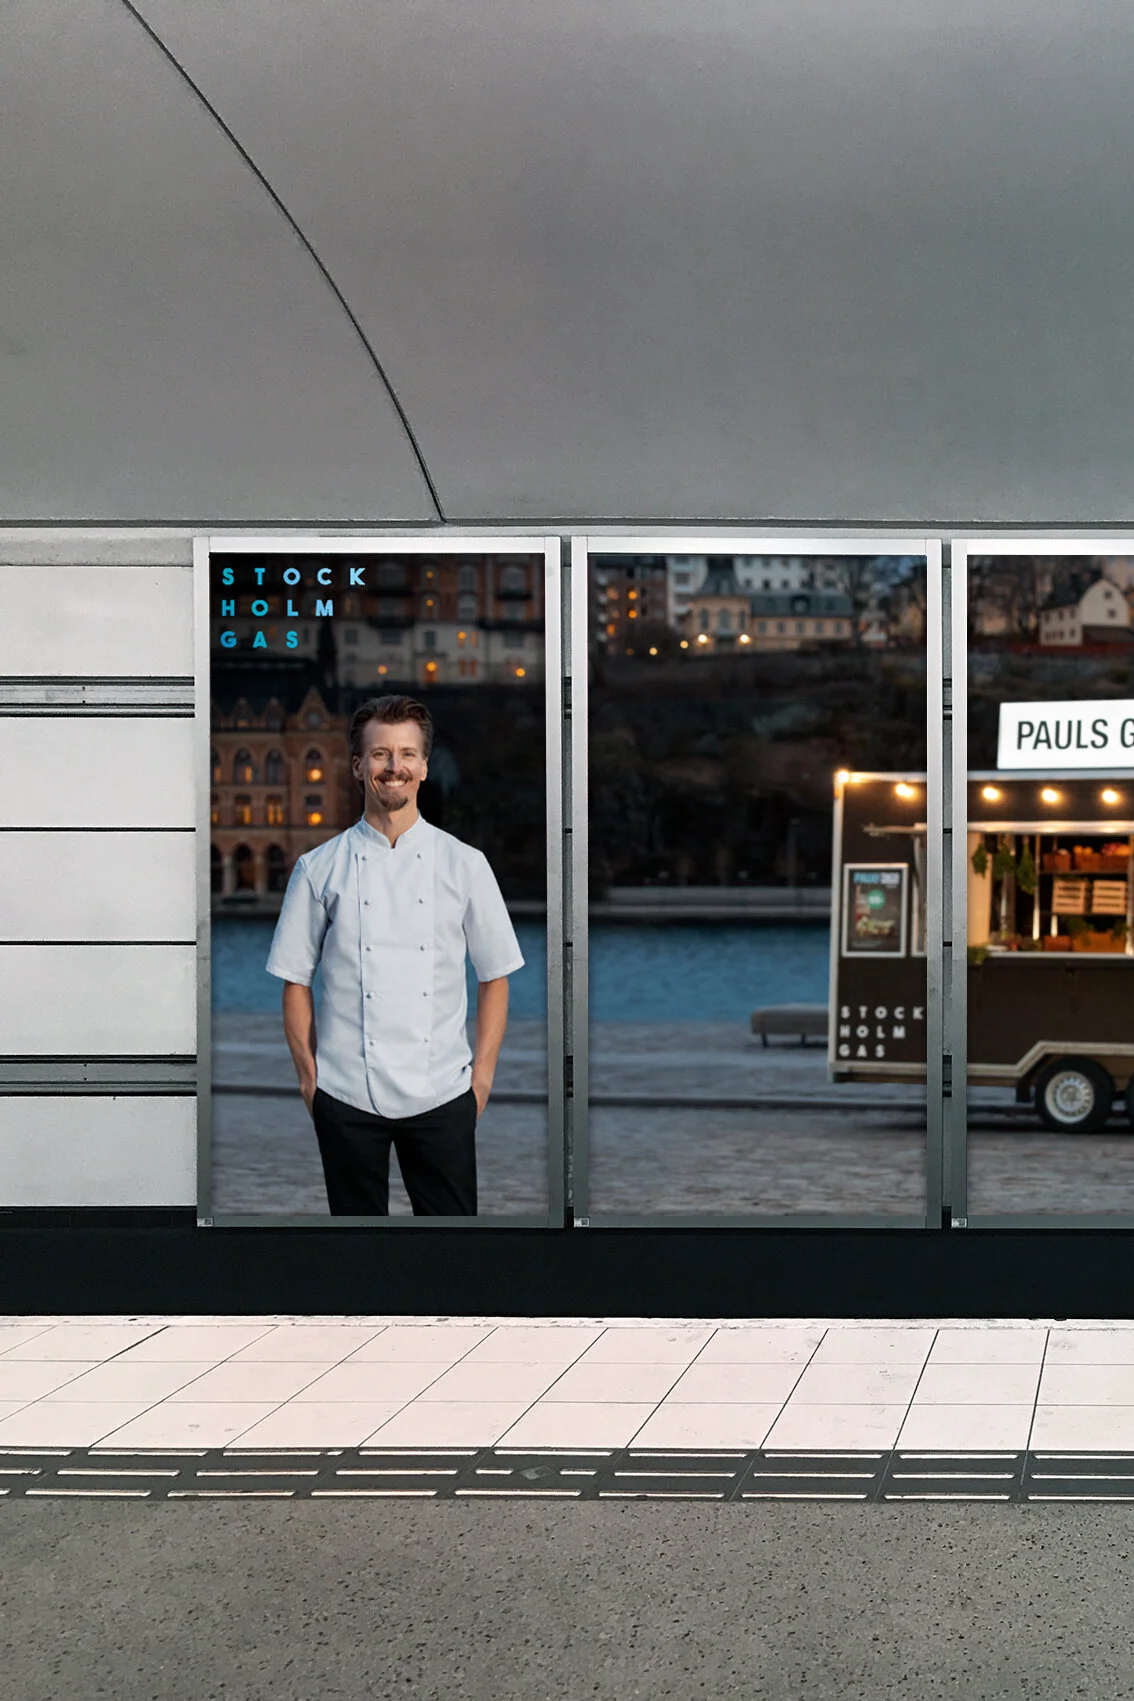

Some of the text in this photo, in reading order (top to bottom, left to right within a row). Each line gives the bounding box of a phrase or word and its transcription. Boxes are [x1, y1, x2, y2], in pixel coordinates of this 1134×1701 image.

[222, 567, 366, 586] STOCK
[221, 599, 334, 617] HOLM
[220, 630, 299, 649] GAS
[1016, 718, 1109, 751] PAULS
[840, 1005, 924, 1020] STOCK
[839, 1024, 906, 1039] HOLM
[838, 1043, 885, 1058] GAS
